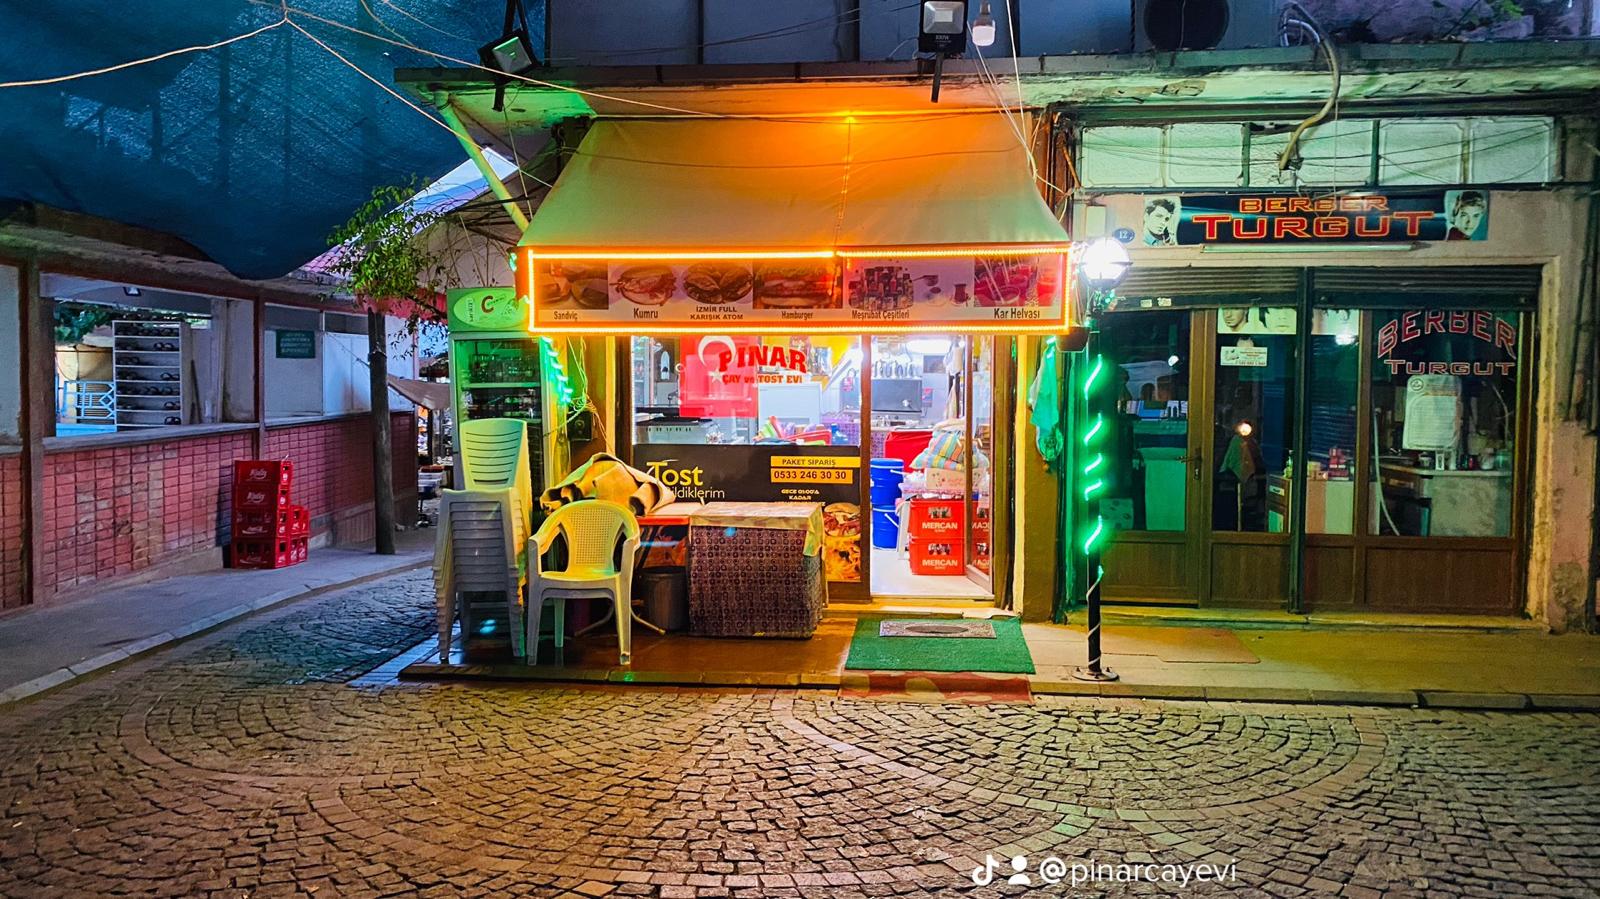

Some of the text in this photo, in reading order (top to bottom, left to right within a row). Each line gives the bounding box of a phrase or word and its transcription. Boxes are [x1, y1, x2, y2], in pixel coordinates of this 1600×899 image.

[1239, 196, 1388, 212] BERBER
[1192, 211, 1434, 239] TURGUT
[554, 310, 579, 321] Sandviç
[633, 308, 659, 319] Kumru
[781, 311, 814, 320] Hamburger
[851, 310, 910, 321] Meşrubat Çeşitleri
[994, 307, 1040, 319] Kar Helvası
[1377, 310, 1518, 360] BERBER
[719, 345, 807, 374] PINAR
[1384, 359, 1516, 376] TURGUT
[722, 374, 740, 385] ÇAY
[758, 375, 784, 383] TOST
[646, 461, 704, 486] Tost
[774, 471, 847, 480] 0533 246 30 30
[672, 486, 725, 499] ildiklerim
[922, 522, 958, 530] MERCAN
